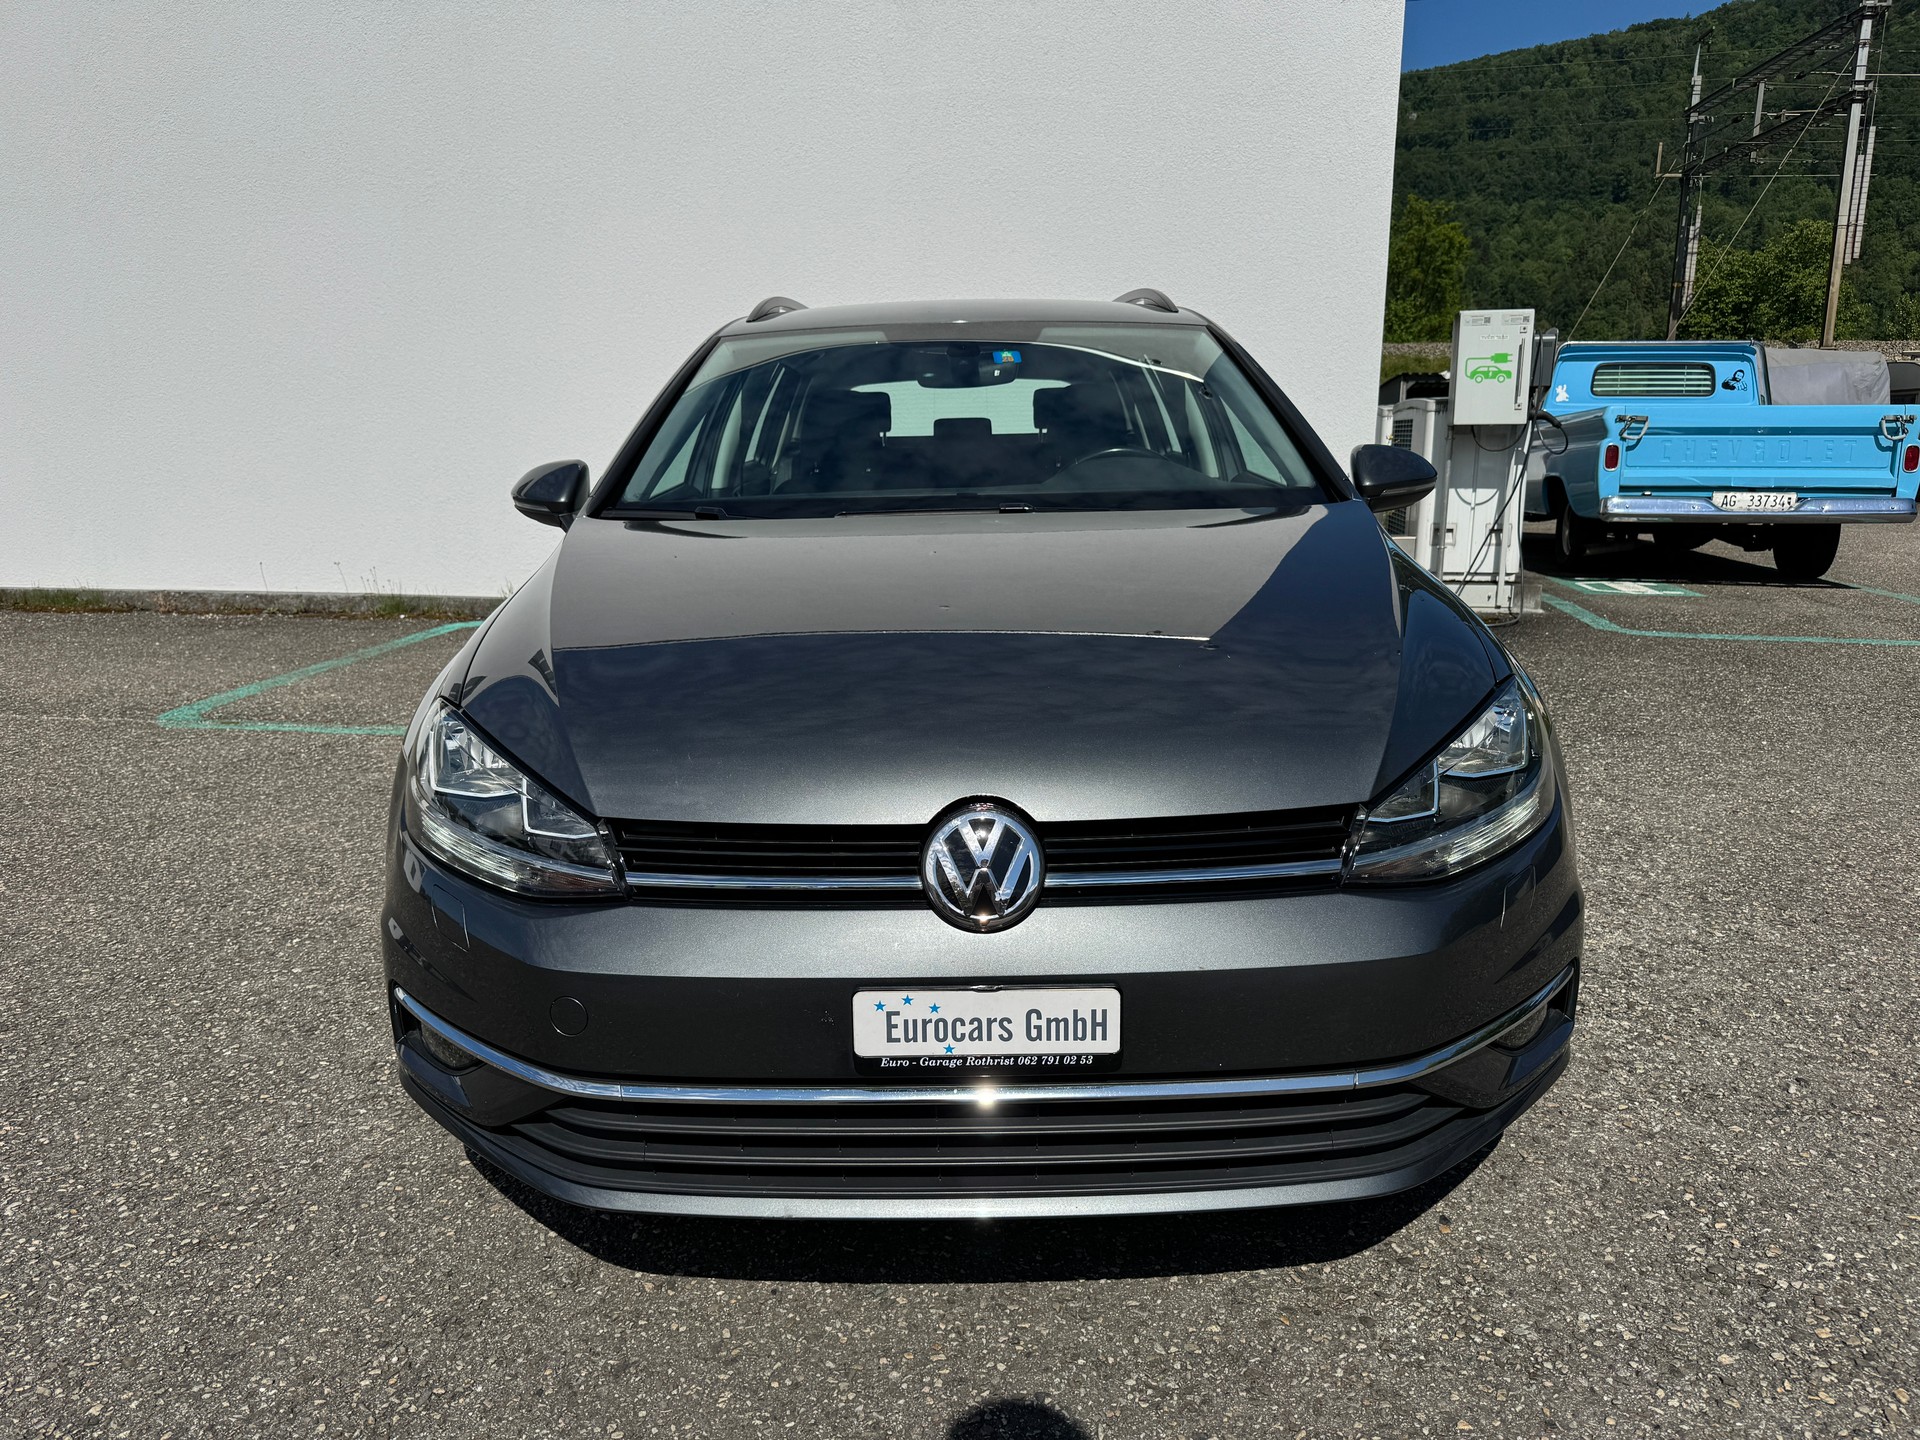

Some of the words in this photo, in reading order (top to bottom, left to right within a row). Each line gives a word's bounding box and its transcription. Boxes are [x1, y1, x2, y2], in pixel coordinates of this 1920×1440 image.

[1659, 440, 1858, 463] CHEVROLET
[1721, 495, 1736, 507] AG
[1747, 495, 1785, 507] 33734
[926, 808, 1041, 920] VW
[885, 1010, 1013, 1043] Eurocars
[1025, 1008, 1108, 1042] GmbH
[880, 1057, 909, 1067] Euro
[919, 1056, 963, 1068] Garage
[965, 1055, 1014, 1066] Rothrist
[1017, 1055, 1038, 1065] 062
[1041, 1055, 1060, 1065] 791
[1063, 1055, 1077, 1065] 02
[1079, 1055, 1094, 1065] 53
